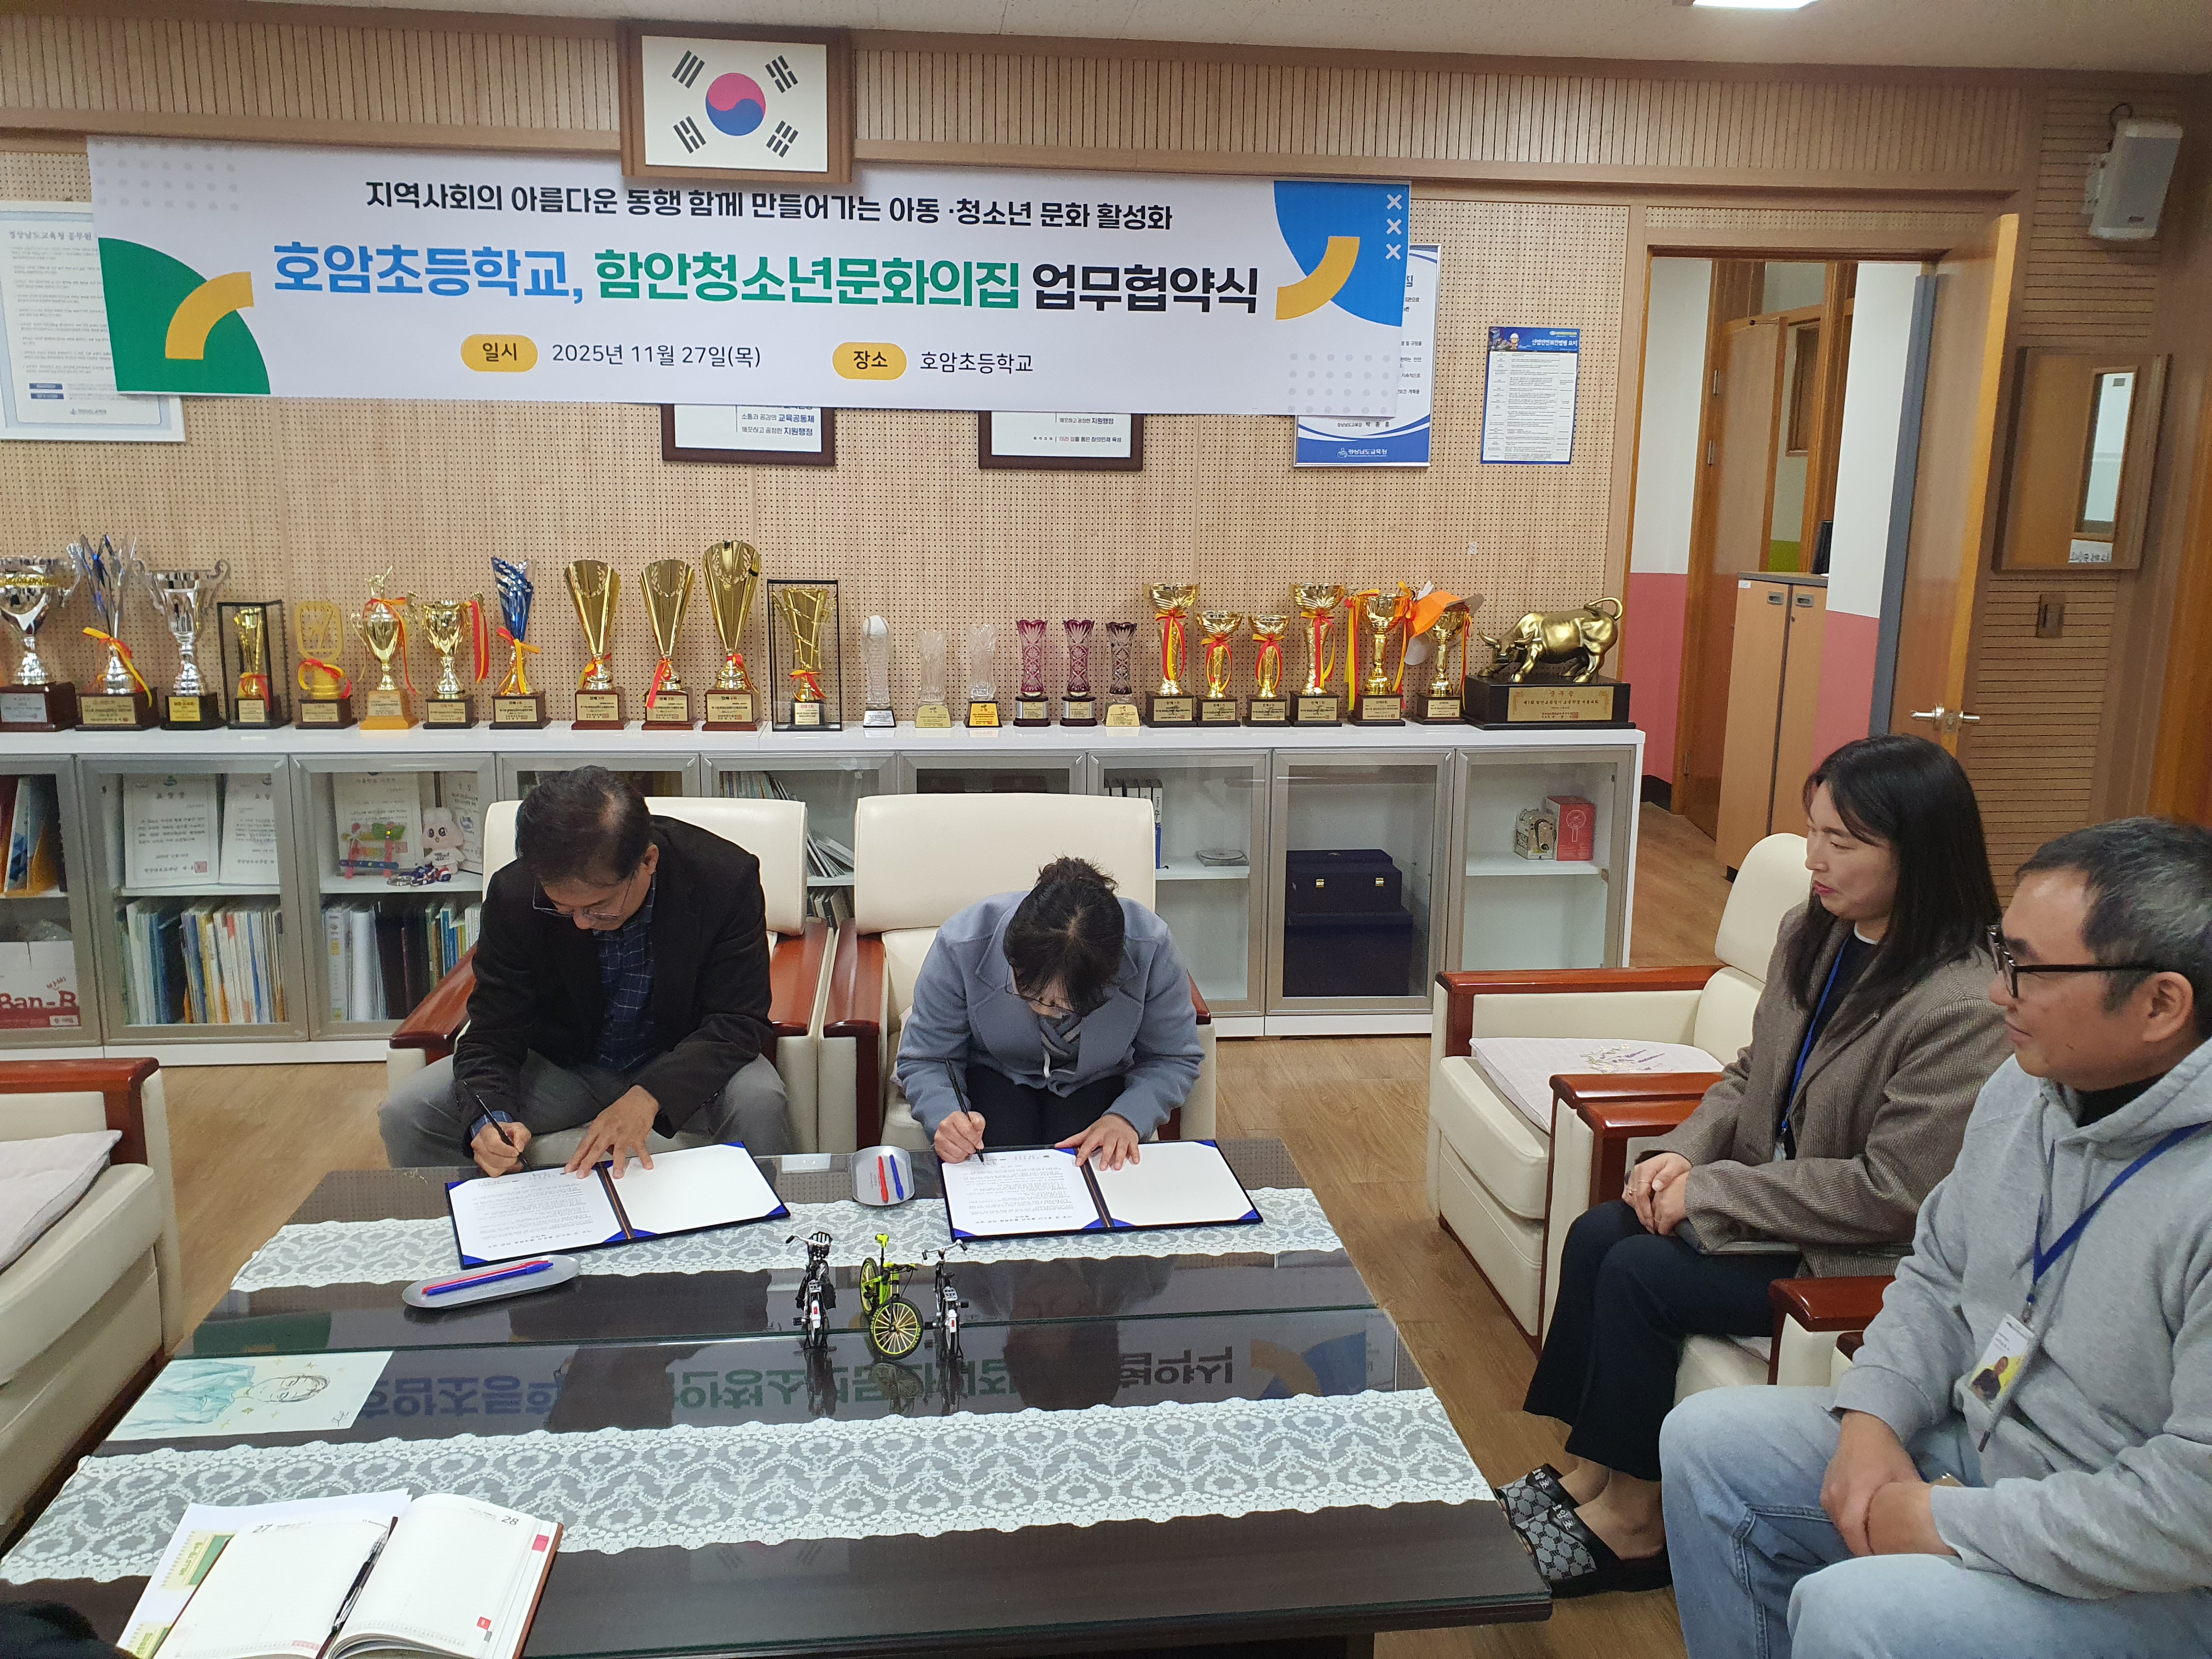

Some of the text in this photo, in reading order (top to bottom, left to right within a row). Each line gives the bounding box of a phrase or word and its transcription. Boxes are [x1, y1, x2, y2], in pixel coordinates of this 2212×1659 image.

[365, 181, 503, 211] 지역사회의
[511, 186, 618, 215] 아름다운
[627, 189, 681, 216] 동행
[688, 190, 743, 217] 함께
[752, 192, 881, 222] 만들어가는
[889, 197, 940, 224] 아동
[1040, 202, 1091, 228] 문화
[1097, 202, 1173, 230] 활성화
[274, 241, 1258, 314] 호암초등학교, 함안청소년문화의집 업무협약식
[482, 342, 760, 368] 일시 2025년 11월 27일(목)
[853, 350, 1034, 375] 장소 호암초등학교
[778, 414, 815, 423] 교육공동체
[784, 427, 813, 436] 지원행정
[252, 1523, 273, 1533] 27
[501, 1515, 519, 1525] 28
[1552, 1504, 1573, 1530] 호암초
